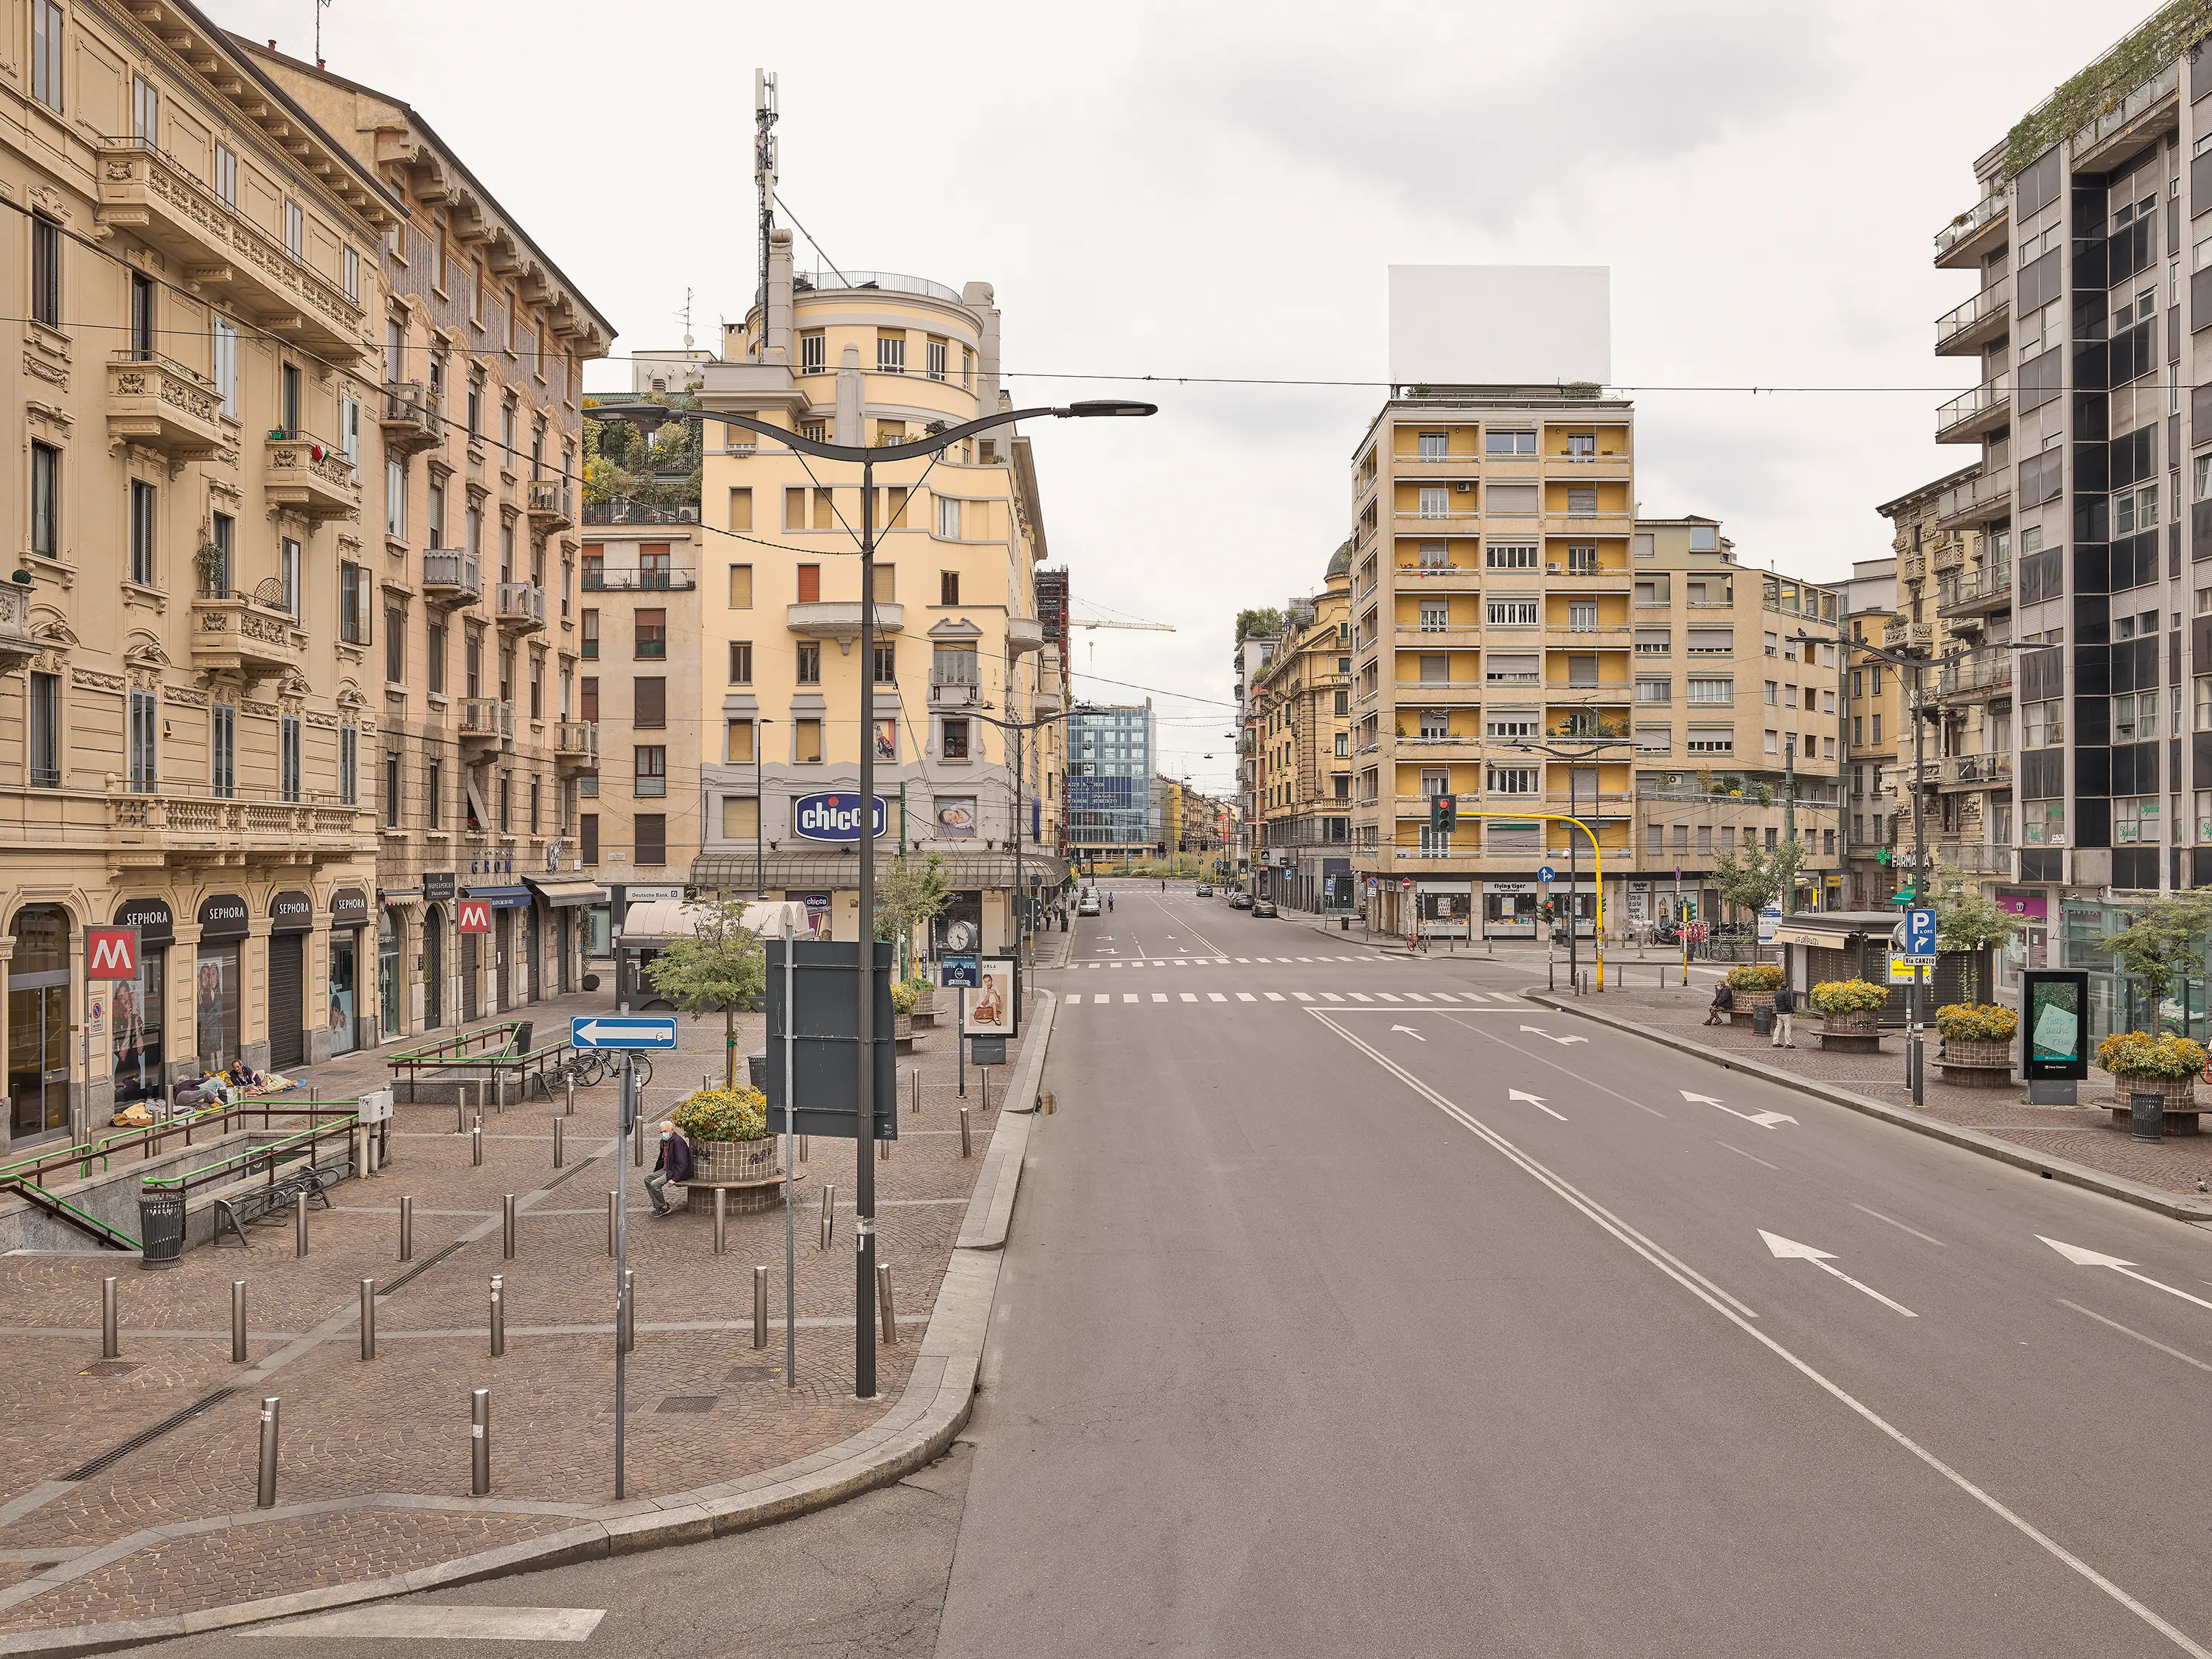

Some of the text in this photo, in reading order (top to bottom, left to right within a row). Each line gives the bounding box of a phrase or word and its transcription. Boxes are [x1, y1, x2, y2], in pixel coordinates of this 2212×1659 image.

[1994, 700, 2010, 709] HOTEL
[1891, 855, 1930, 868] FARMAA
[338, 898, 365, 910] SEPHORA
[807, 896, 827, 905] chicco
[209, 906, 244, 920] SEPHORA
[279, 902, 309, 914] SEPHORA
[127, 911, 168, 926] SEPHORA
[461, 907, 487, 926] M
[1913, 912, 1930, 934] P
[91, 939, 132, 969] M
